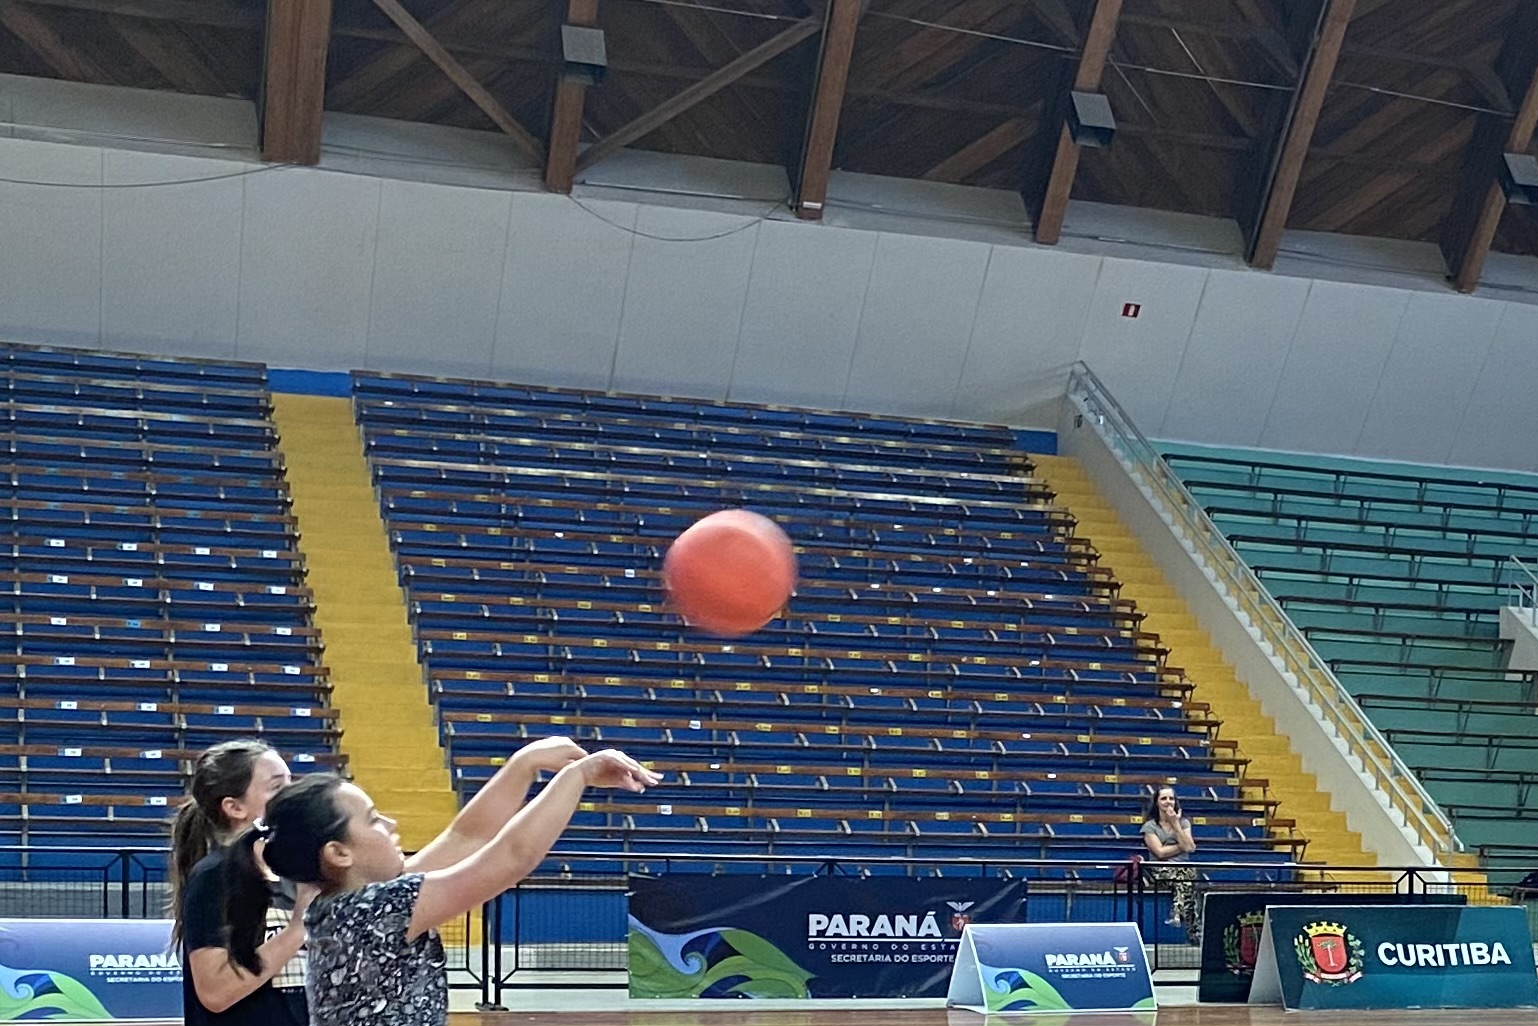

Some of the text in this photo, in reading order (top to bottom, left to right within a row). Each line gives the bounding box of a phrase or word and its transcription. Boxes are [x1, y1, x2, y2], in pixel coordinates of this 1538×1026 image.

[808, 911, 942, 937] PARANÁ
[808, 942, 956, 951] GOVERNO DO ESTA
[1377, 941, 1512, 967] CURITIBA
[893, 954, 909, 963] DO
[911, 954, 955, 963] ESPORTE
[1044, 951, 1117, 967] PARANÁ
